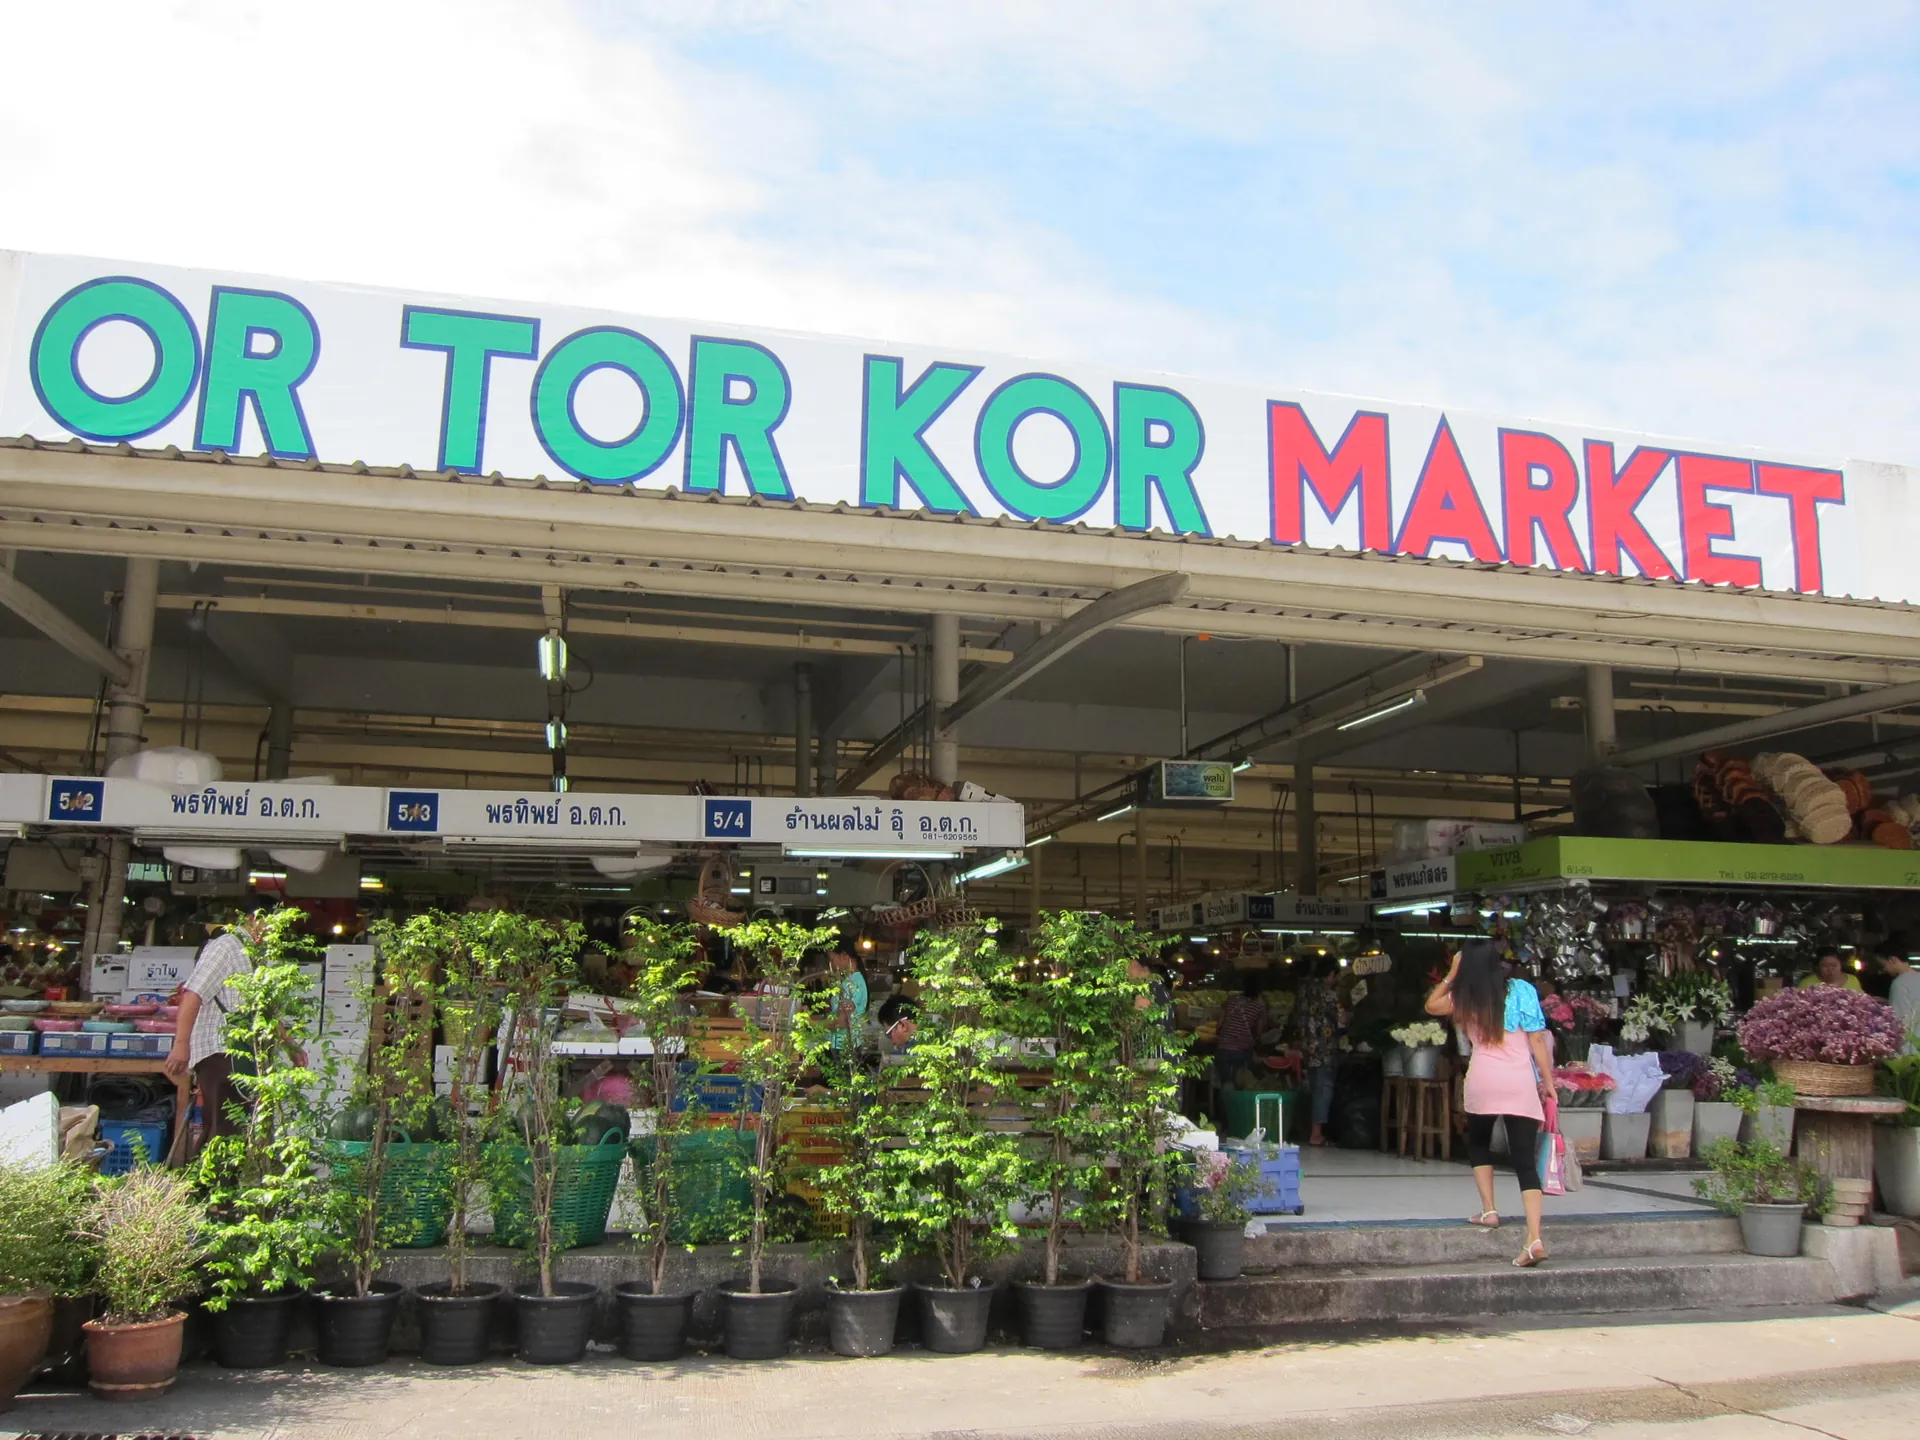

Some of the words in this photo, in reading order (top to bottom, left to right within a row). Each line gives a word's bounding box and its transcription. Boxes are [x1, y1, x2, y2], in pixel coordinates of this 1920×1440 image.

[29, 275, 321, 458] OR
[400, 304, 795, 499] TOR
[859, 353, 1214, 538] KOR
[1266, 398, 1846, 594] MARKET
[171, 787, 250, 817] พรทิพย์
[259, 797, 320, 818] อ.ต.ก.
[486, 798, 561, 824] พรทิพย์
[569, 805, 626, 826] อ.ต.ก.
[713, 811, 745, 829] 5/4
[785, 805, 882, 831] ร้านผลไม้
[918, 816, 978, 833] อ.ต.ก.
